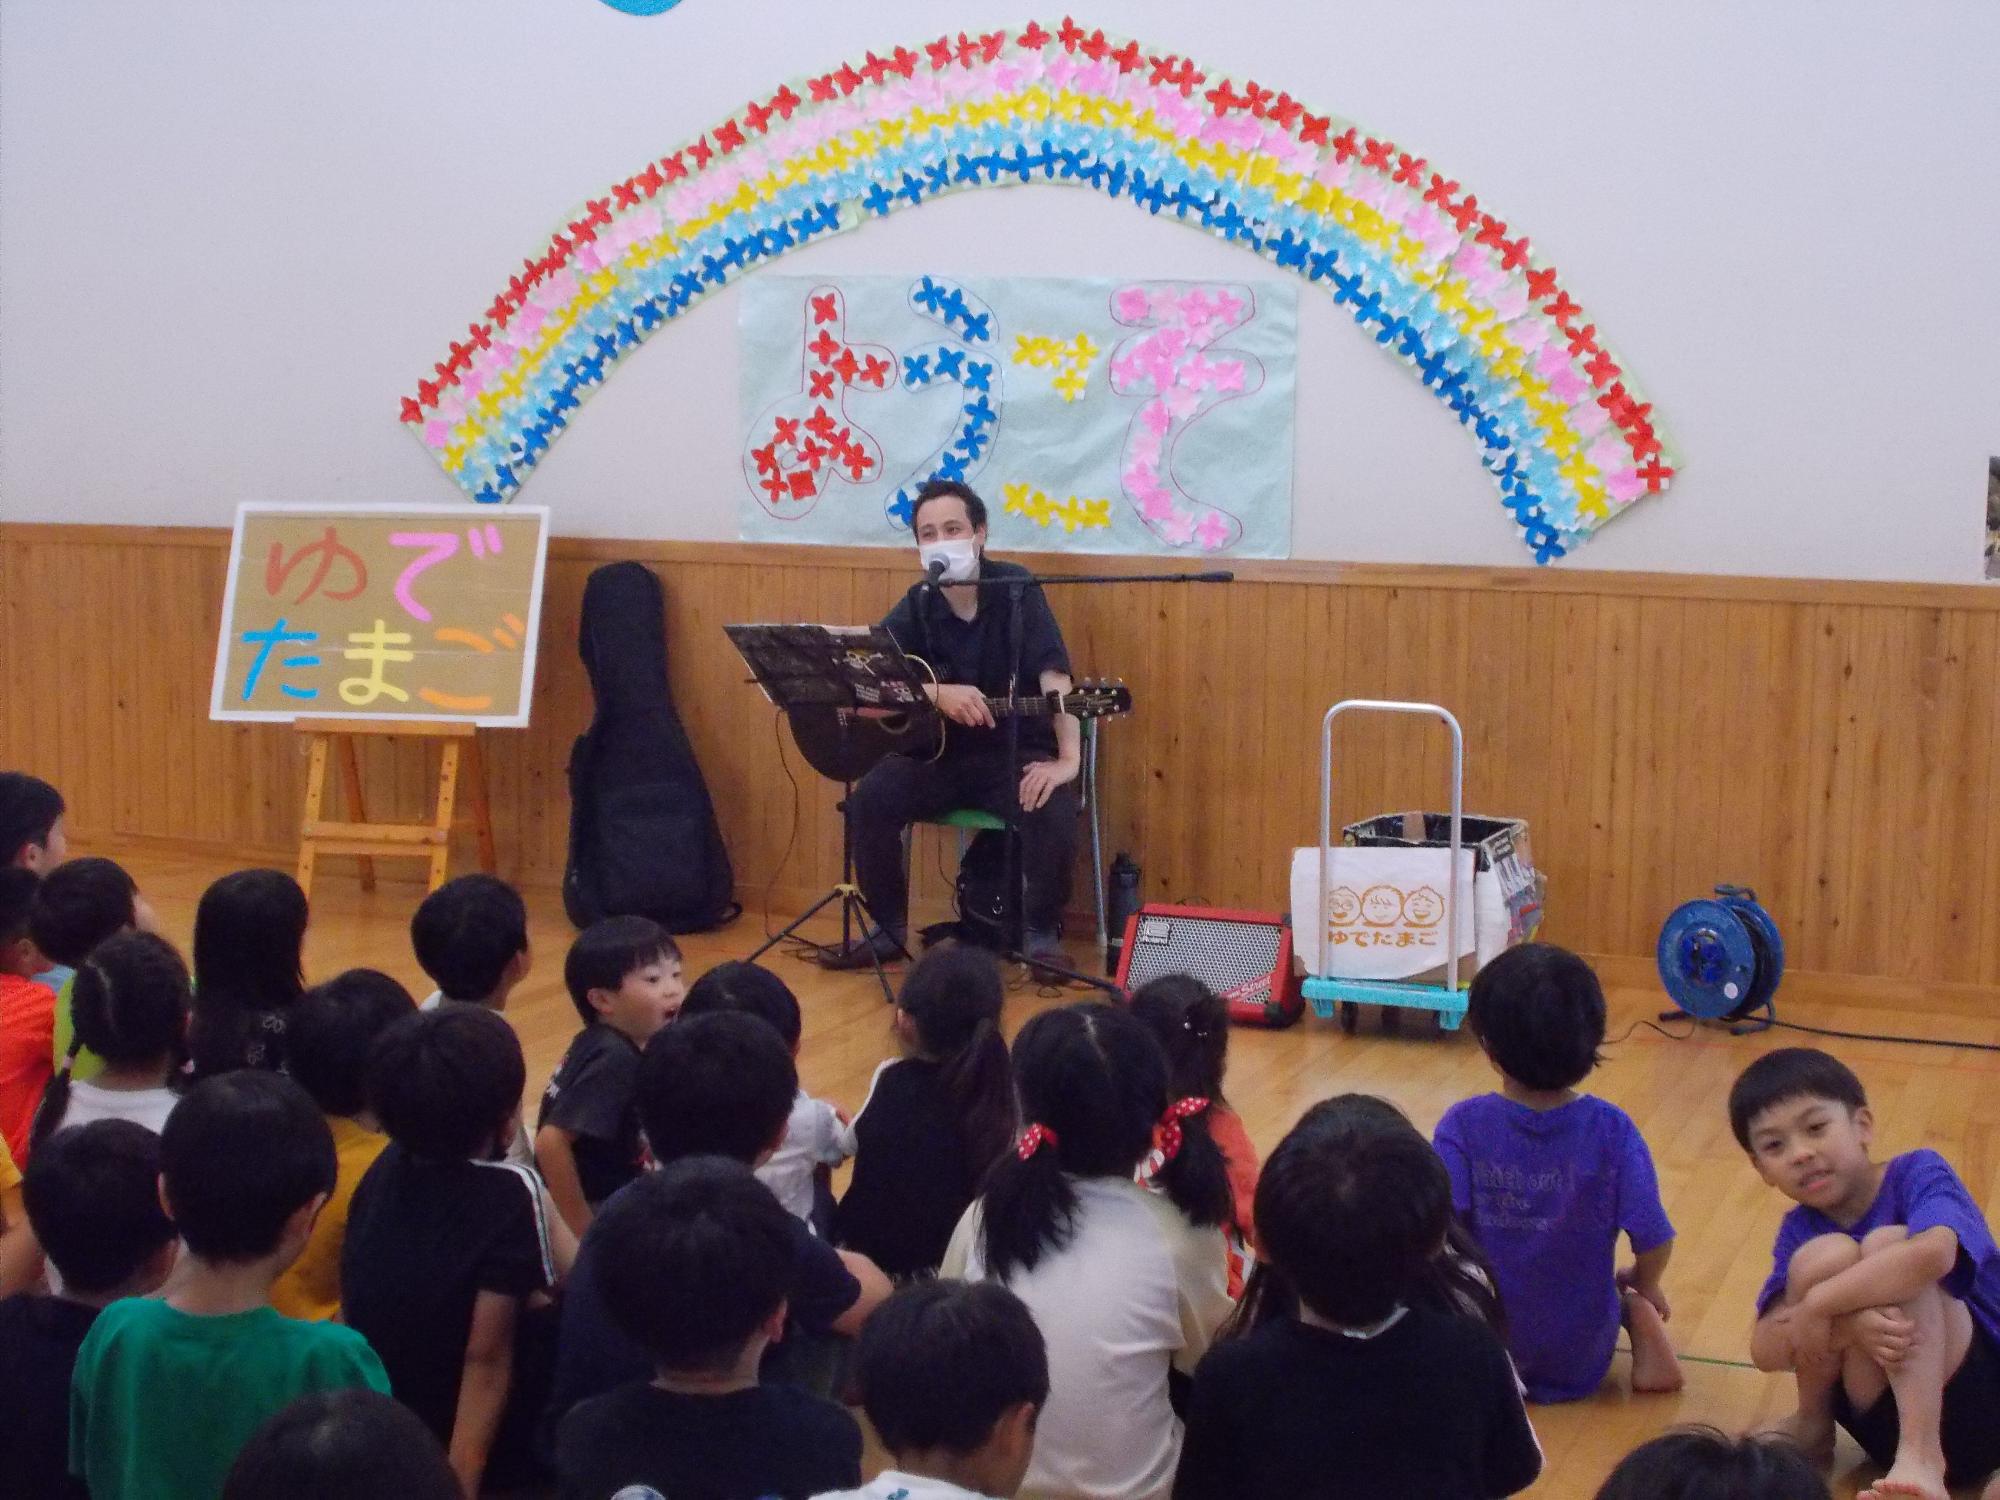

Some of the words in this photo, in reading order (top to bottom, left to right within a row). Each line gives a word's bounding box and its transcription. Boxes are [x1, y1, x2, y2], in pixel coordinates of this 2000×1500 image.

[743, 276, 1265, 552] ようこそ
[264, 523, 503, 622] ゆで
[240, 617, 526, 705] たまご
[1328, 930, 1439, 948] ゆでたまご
